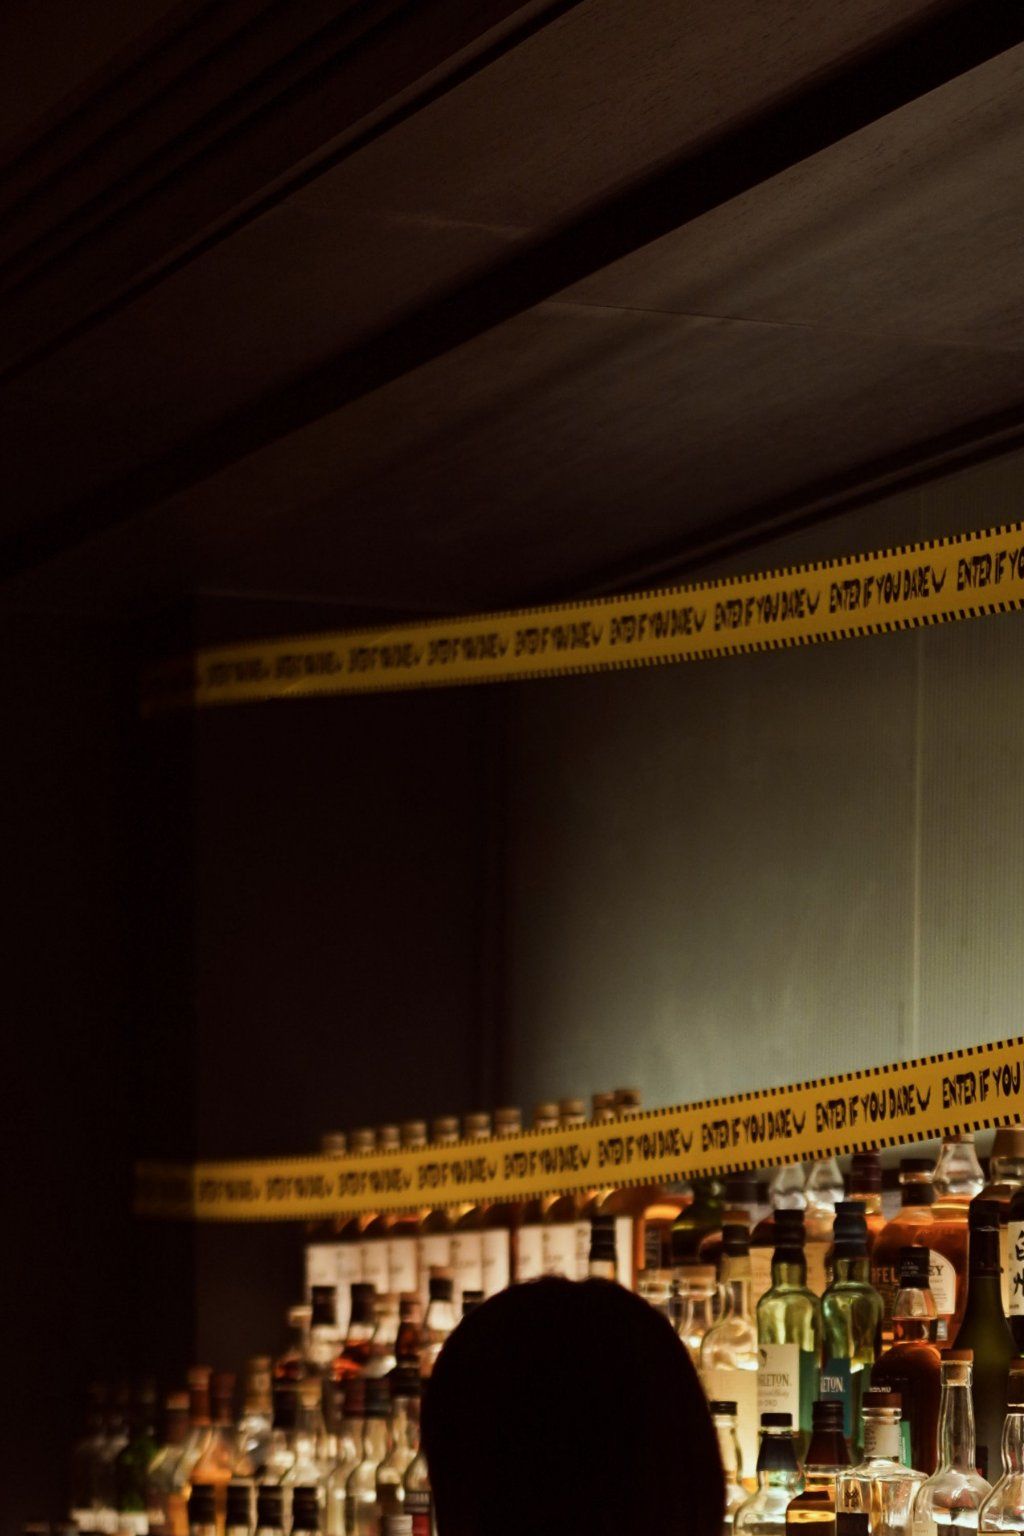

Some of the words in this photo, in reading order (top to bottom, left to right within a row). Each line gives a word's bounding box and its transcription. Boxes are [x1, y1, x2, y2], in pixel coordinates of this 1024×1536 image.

[829, 577, 861, 614] ENTER
[863, 575, 875, 608] IF
[876, 570, 901, 603] YOU
[903, 565, 930, 600] DARE
[957, 553, 992, 591] ENTER
[994, 550, 1007, 584] IF
[816, 1099, 846, 1133] ENTER
[849, 1095, 859, 1126] IF
[860, 1090, 887, 1122] YOU
[889, 1084, 916, 1119] DARE
[942, 1071, 976, 1109] ENTER
[979, 1067, 990, 1101] IF
[992, 1061, 1021, 1097] YOU
